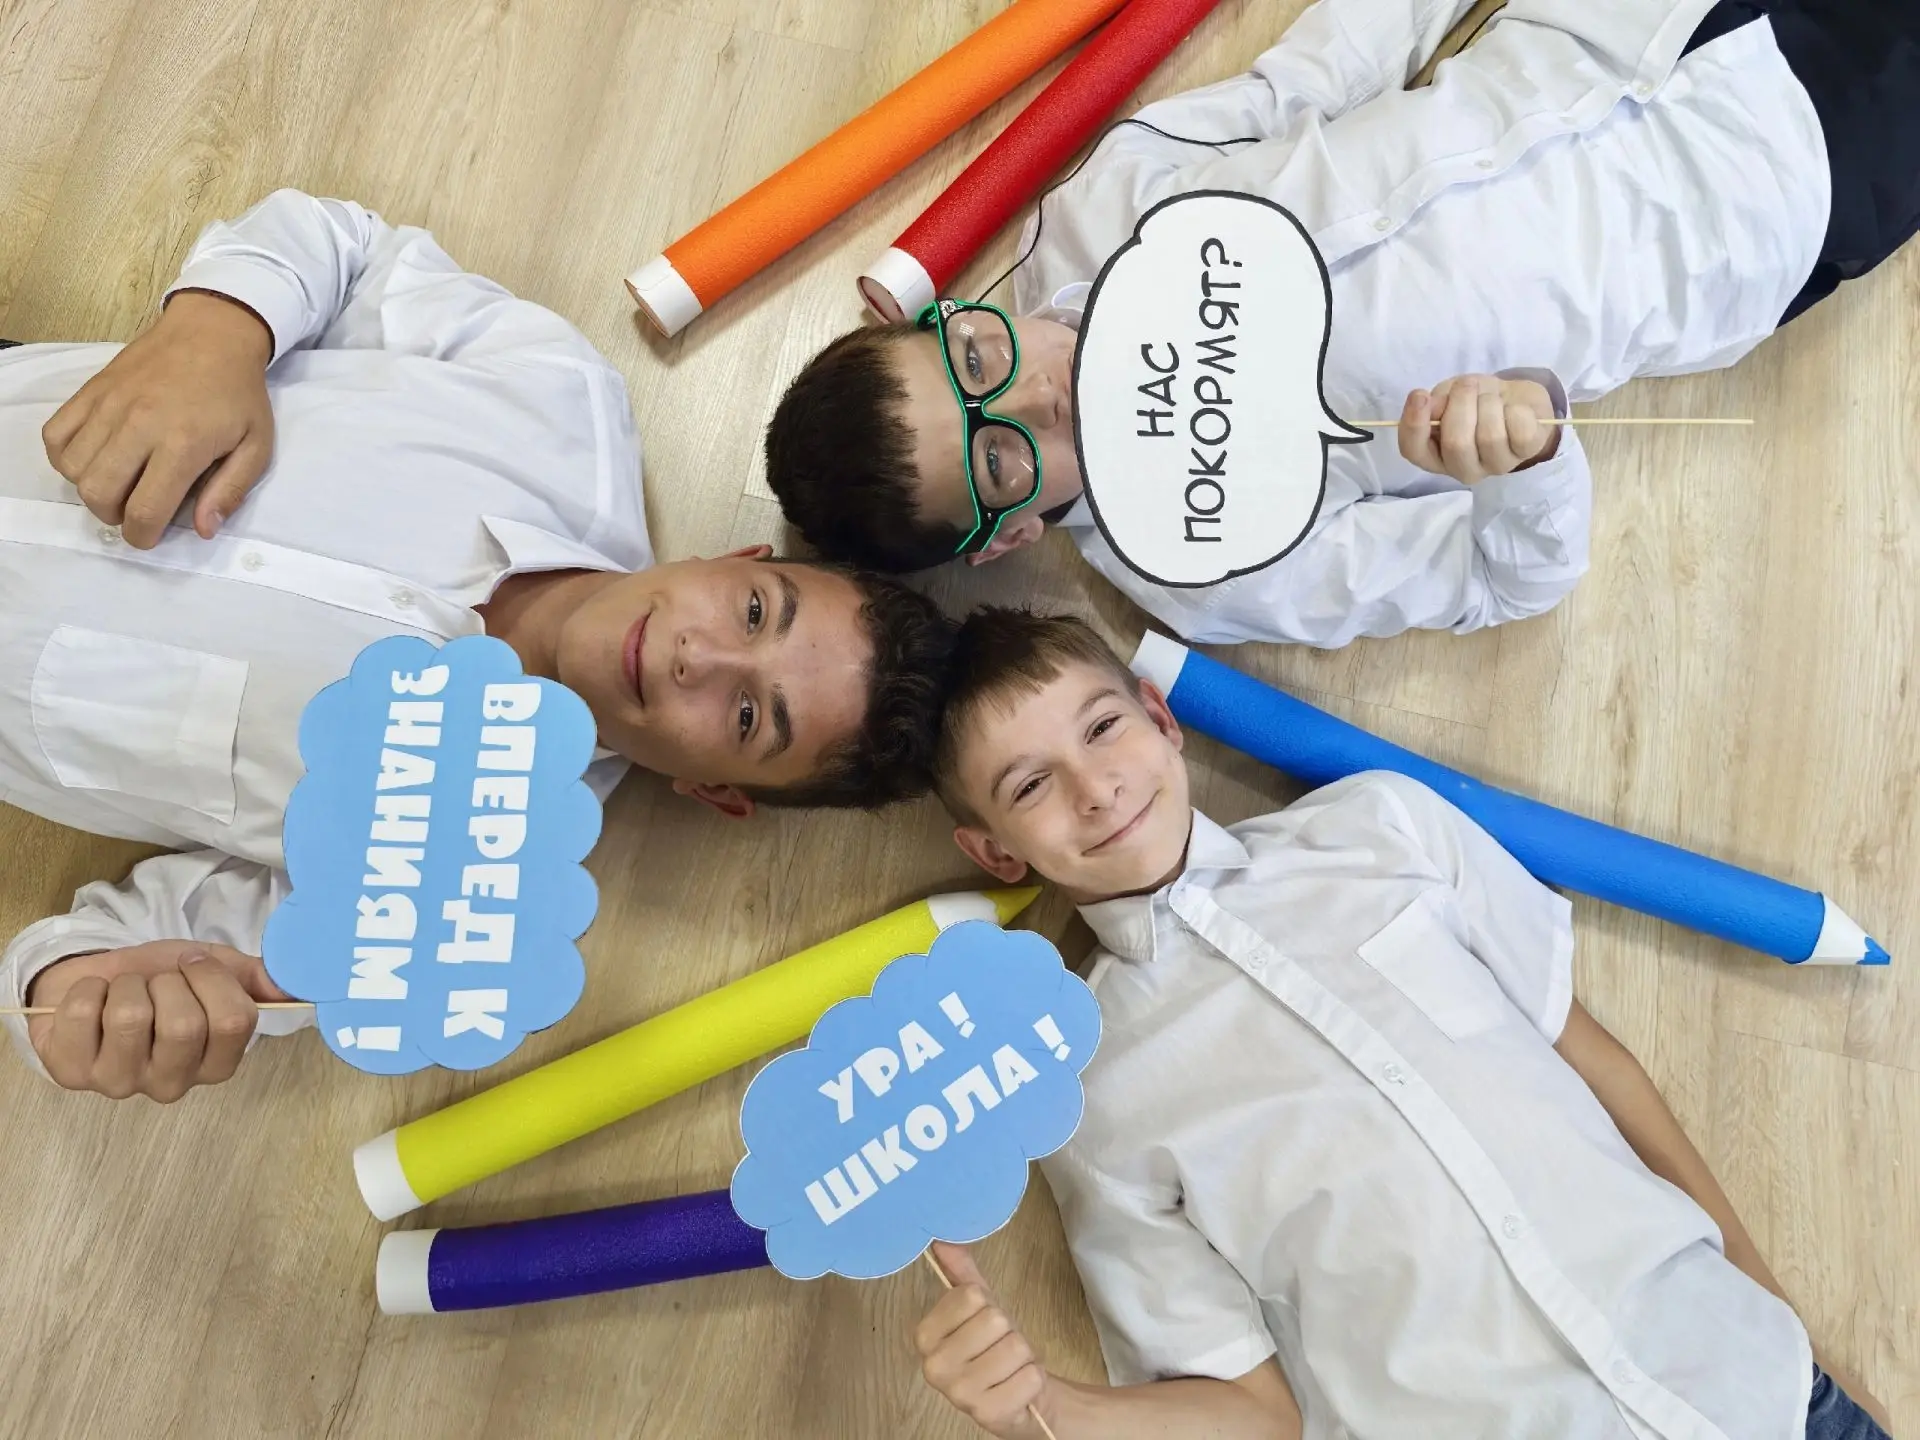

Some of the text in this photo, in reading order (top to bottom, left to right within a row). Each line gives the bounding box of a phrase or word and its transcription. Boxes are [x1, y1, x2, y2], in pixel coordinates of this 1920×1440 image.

[1136, 342, 1180, 437] НАС
[1183, 237, 1243, 543] ПОКОРМЯТ?
[436, 682, 542, 1041] ВПЕРЕД К
